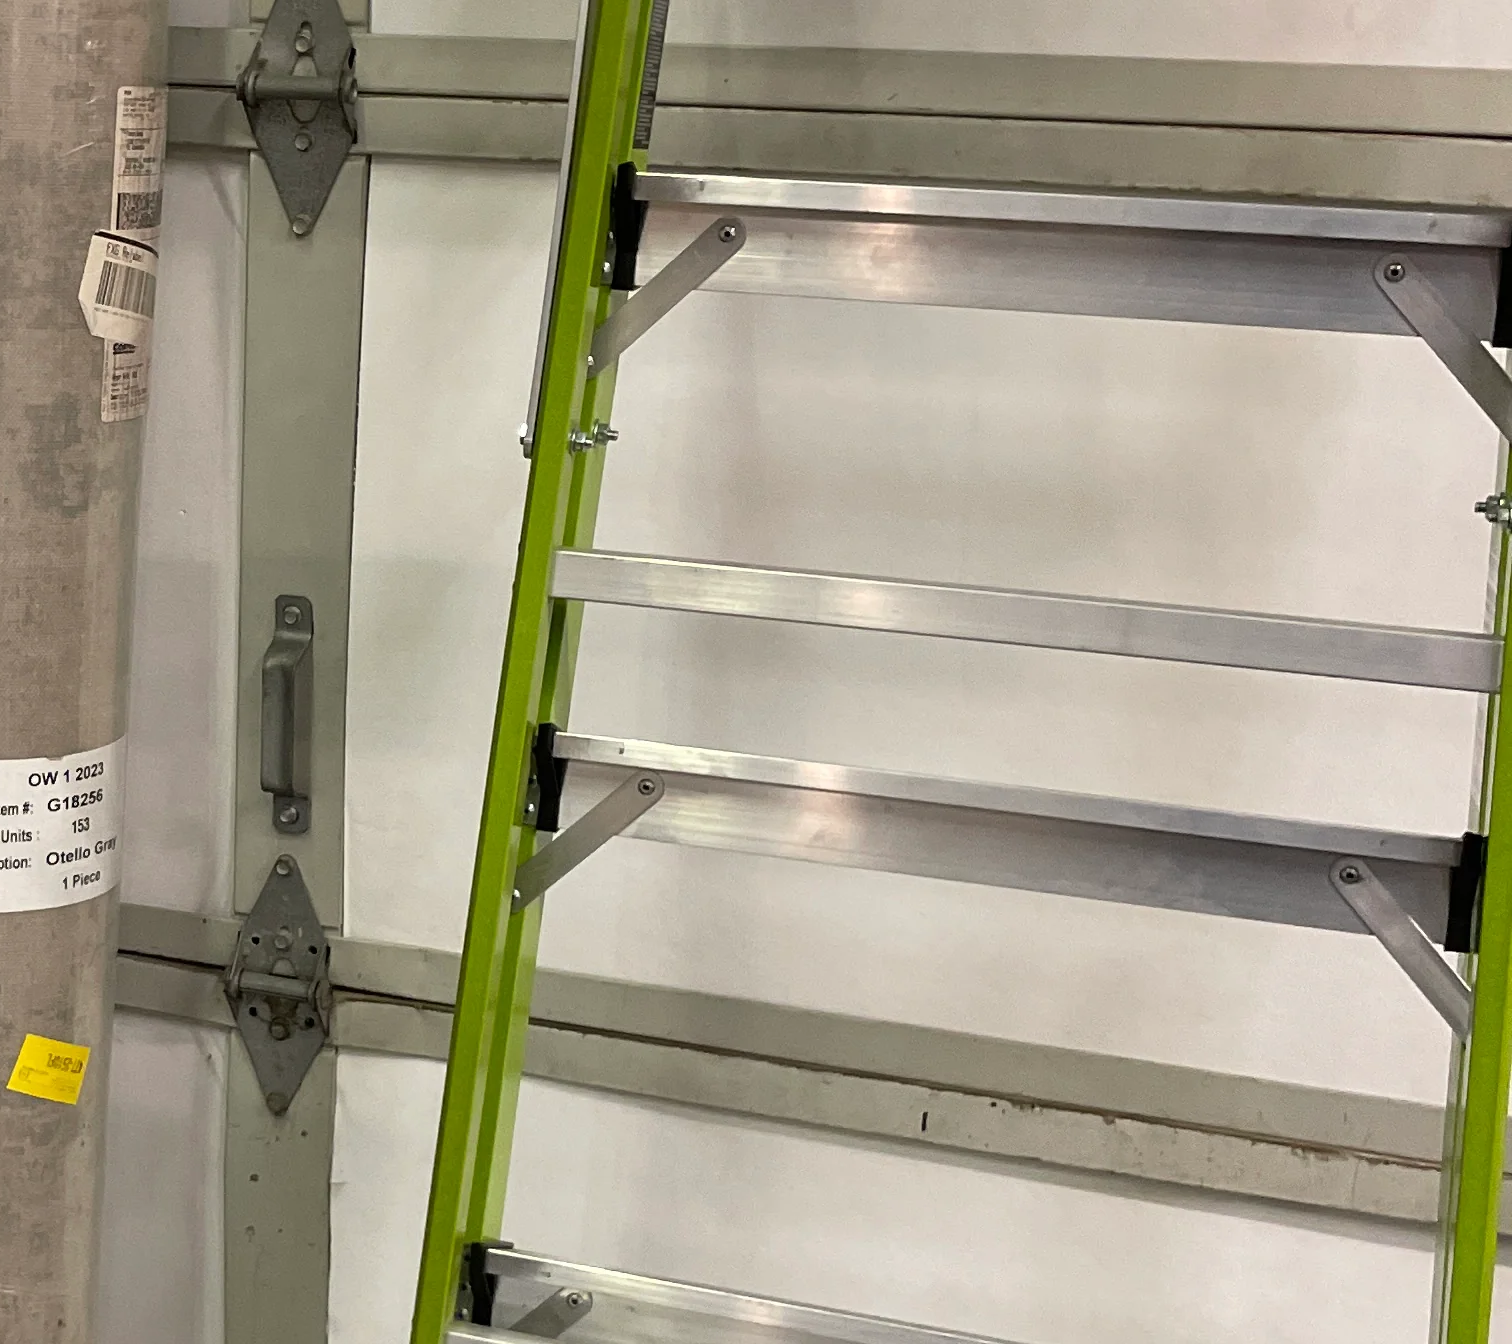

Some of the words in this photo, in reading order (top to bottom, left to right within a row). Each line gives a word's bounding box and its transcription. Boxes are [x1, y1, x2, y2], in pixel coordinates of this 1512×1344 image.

[28, 771, 58, 787] OW
[63, 769, 70, 783] 1
[75, 761, 104, 781] 2023
[47, 788, 103, 812] G18256
[1, 828, 33, 843] Units
[72, 817, 90, 834] 153
[46, 847, 91, 866] Otello
[94, 836, 118, 855] Gray
[62, 877, 69, 890] 1
[72, 870, 101, 888] Piece
